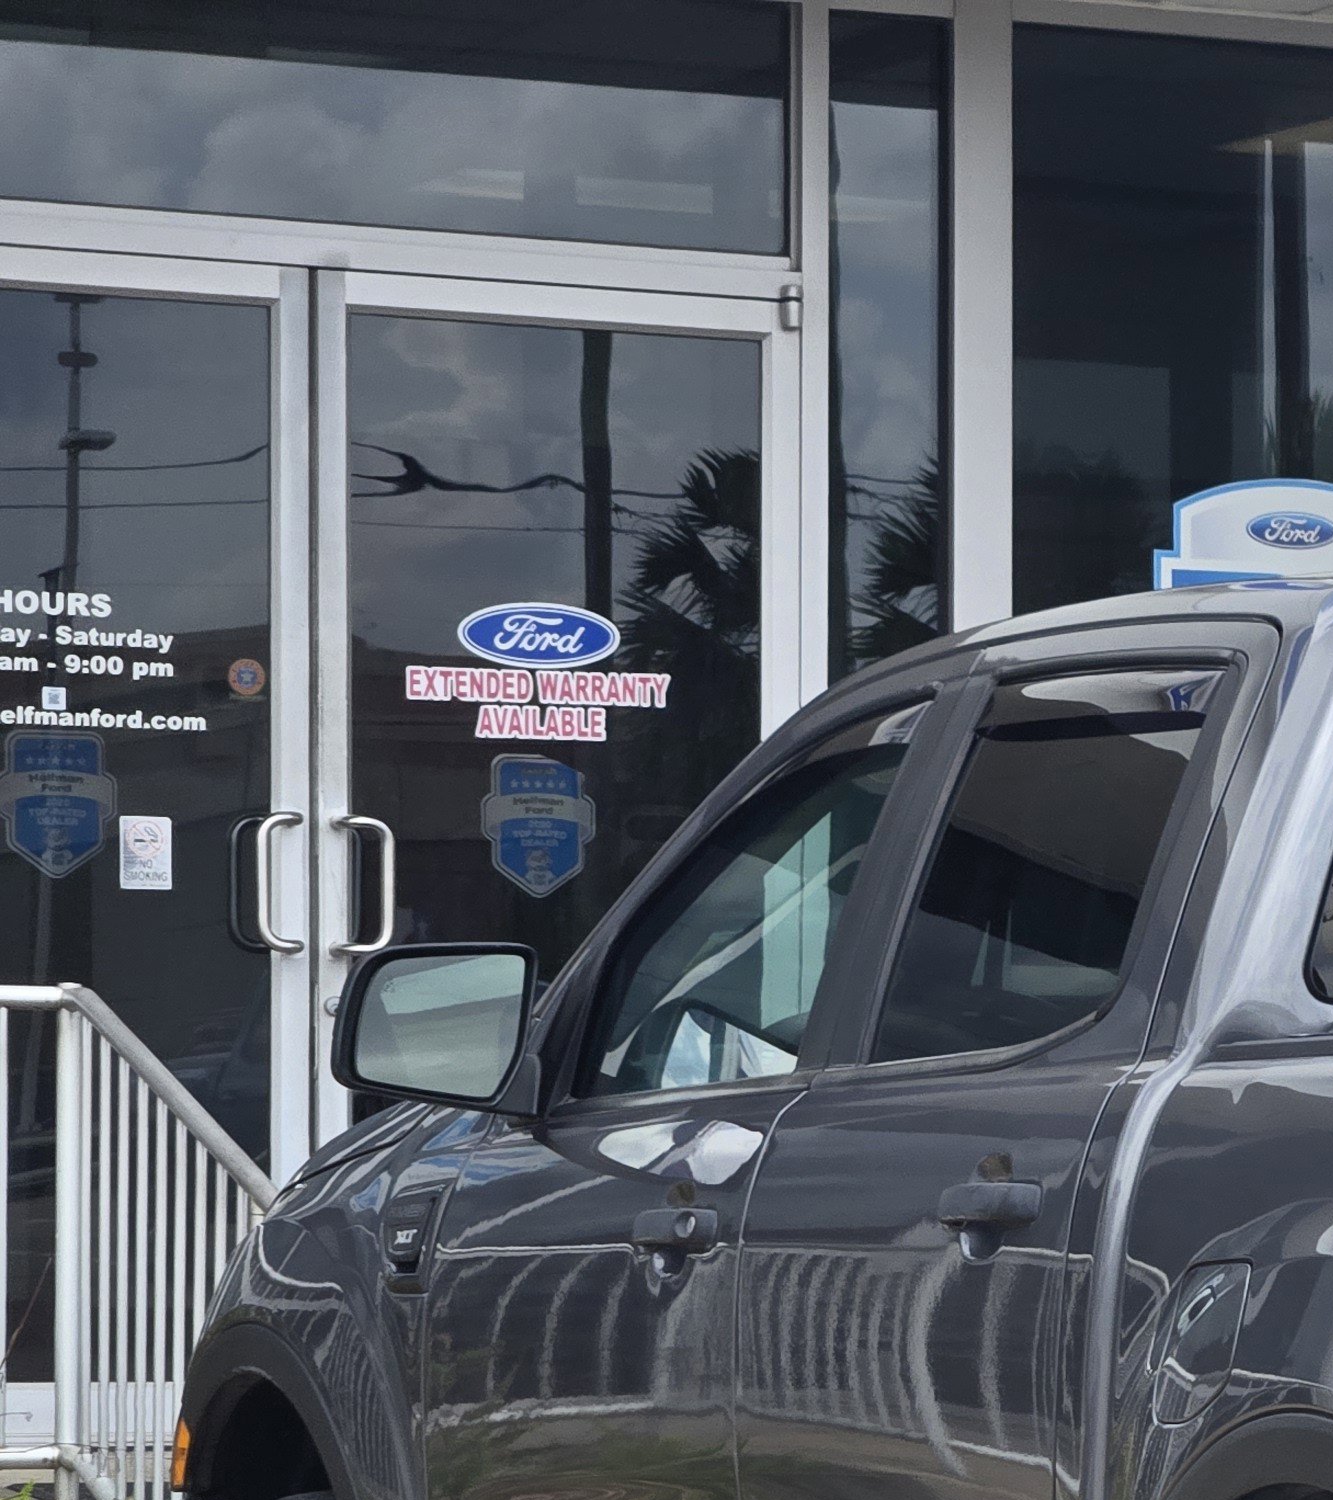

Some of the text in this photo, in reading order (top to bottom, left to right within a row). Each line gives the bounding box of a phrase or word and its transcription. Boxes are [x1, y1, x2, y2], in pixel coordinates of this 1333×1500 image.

[1264, 515, 1322, 544] Ford
[0, 589, 113, 618] HOURS
[55, 626, 175, 655] Saturday
[493, 613, 586, 654] Ford
[63, 654, 125, 676] 9:00
[132, 660, 175, 680] pm
[408, 668, 668, 706] EXTENDED WARRANTY
[478, 706, 606, 739] AVAILABLE
[123, 871, 168, 882] SMOKING
[139, 859, 153, 869] NO
